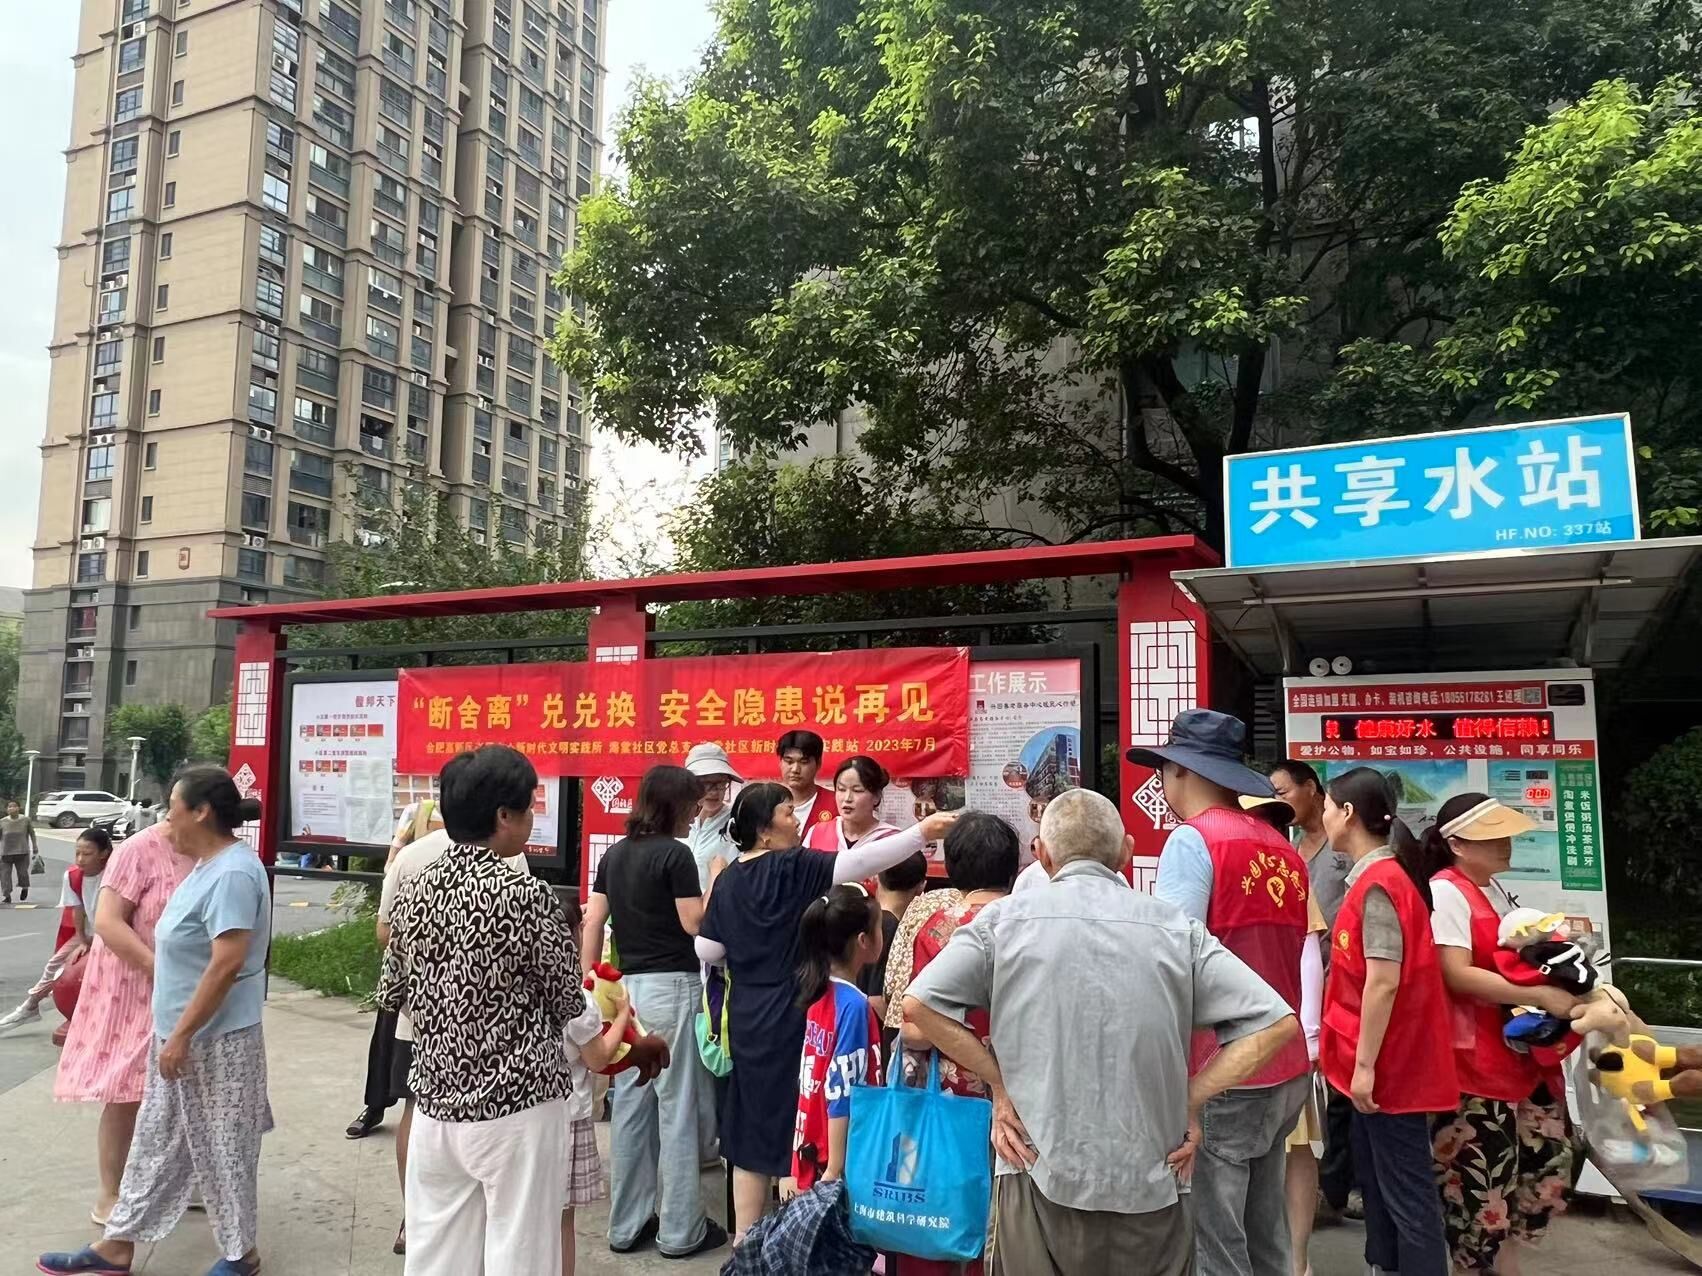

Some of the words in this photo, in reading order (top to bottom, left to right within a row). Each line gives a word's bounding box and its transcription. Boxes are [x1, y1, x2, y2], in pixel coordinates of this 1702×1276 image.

[1249, 434, 1603, 535] 共享水站
[969, 671, 1047, 694] 工作展示
[659, 681, 934, 728] 安全隐患说再见
[1355, 719, 1437, 739] 健康好水
[866, 737, 936, 752] 2023年7月
